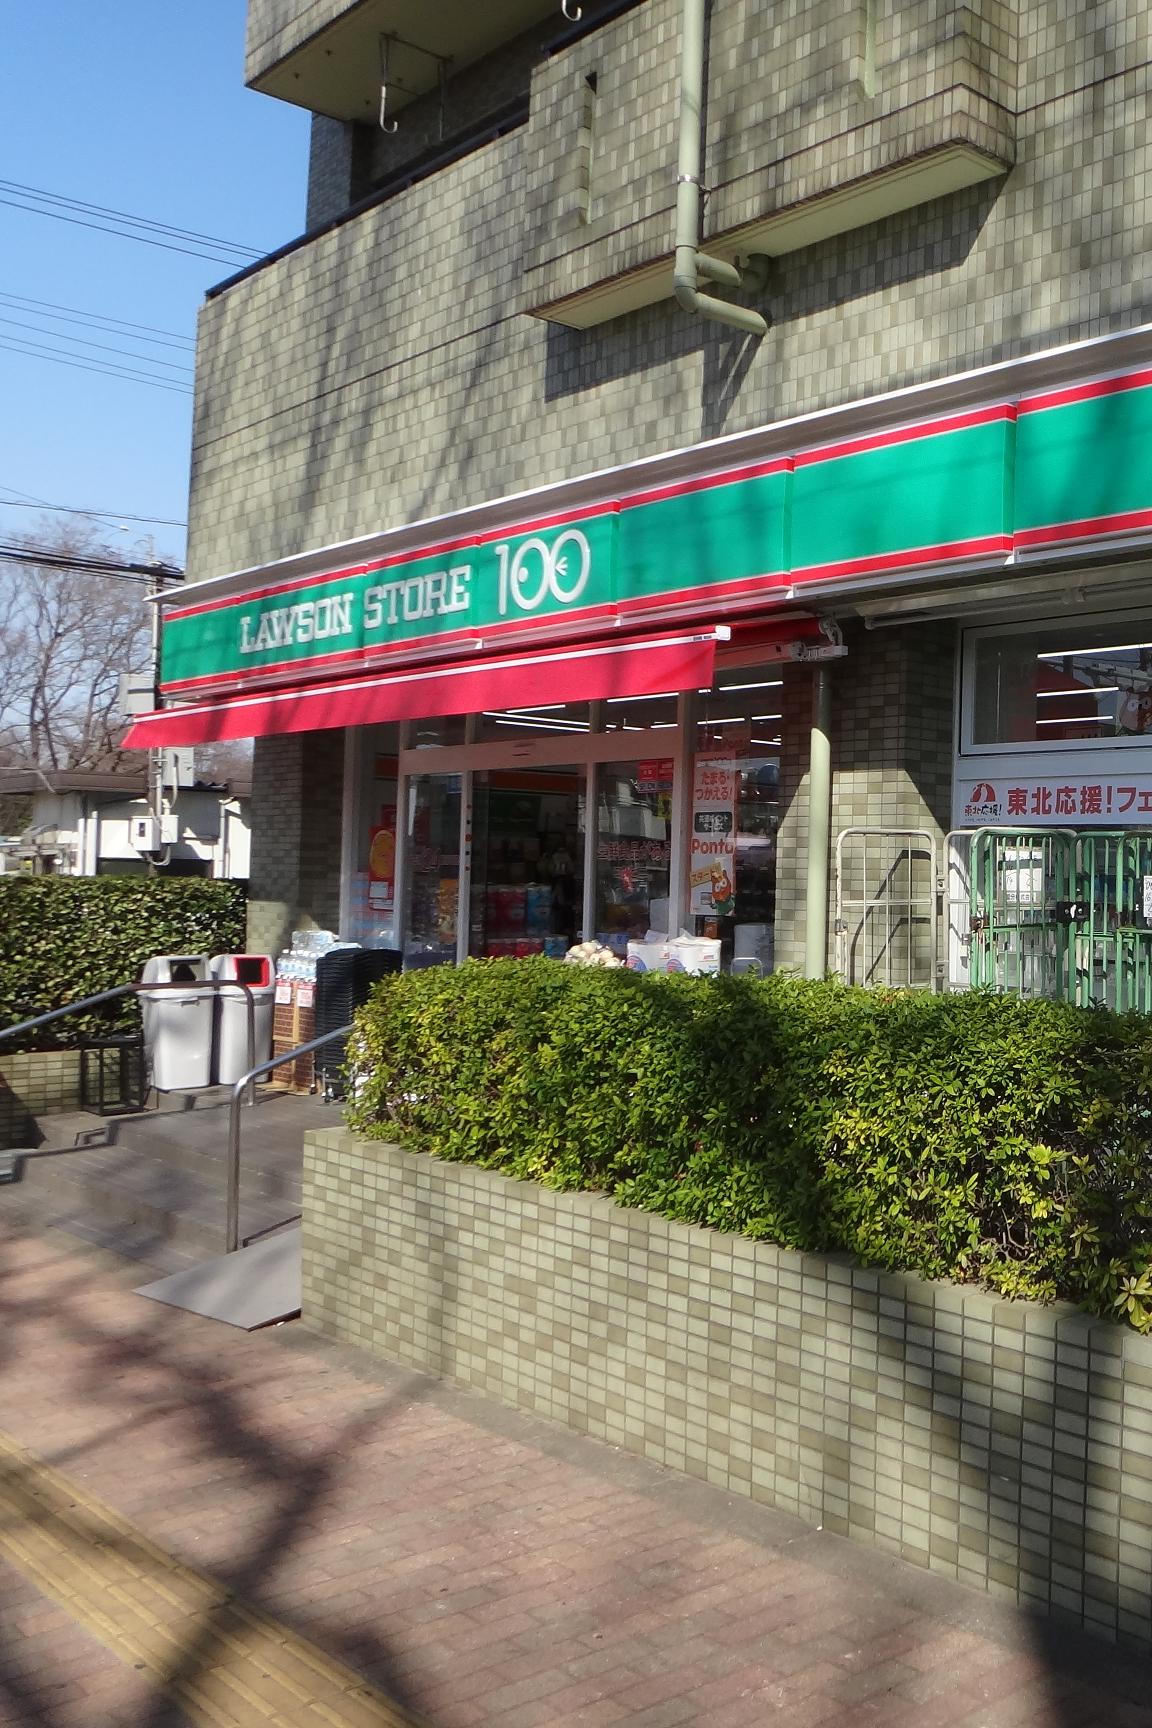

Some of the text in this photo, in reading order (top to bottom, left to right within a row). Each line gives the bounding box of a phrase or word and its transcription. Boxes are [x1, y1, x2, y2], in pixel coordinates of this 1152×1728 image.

[239, 529, 592, 653] LAWSON STORE 100
